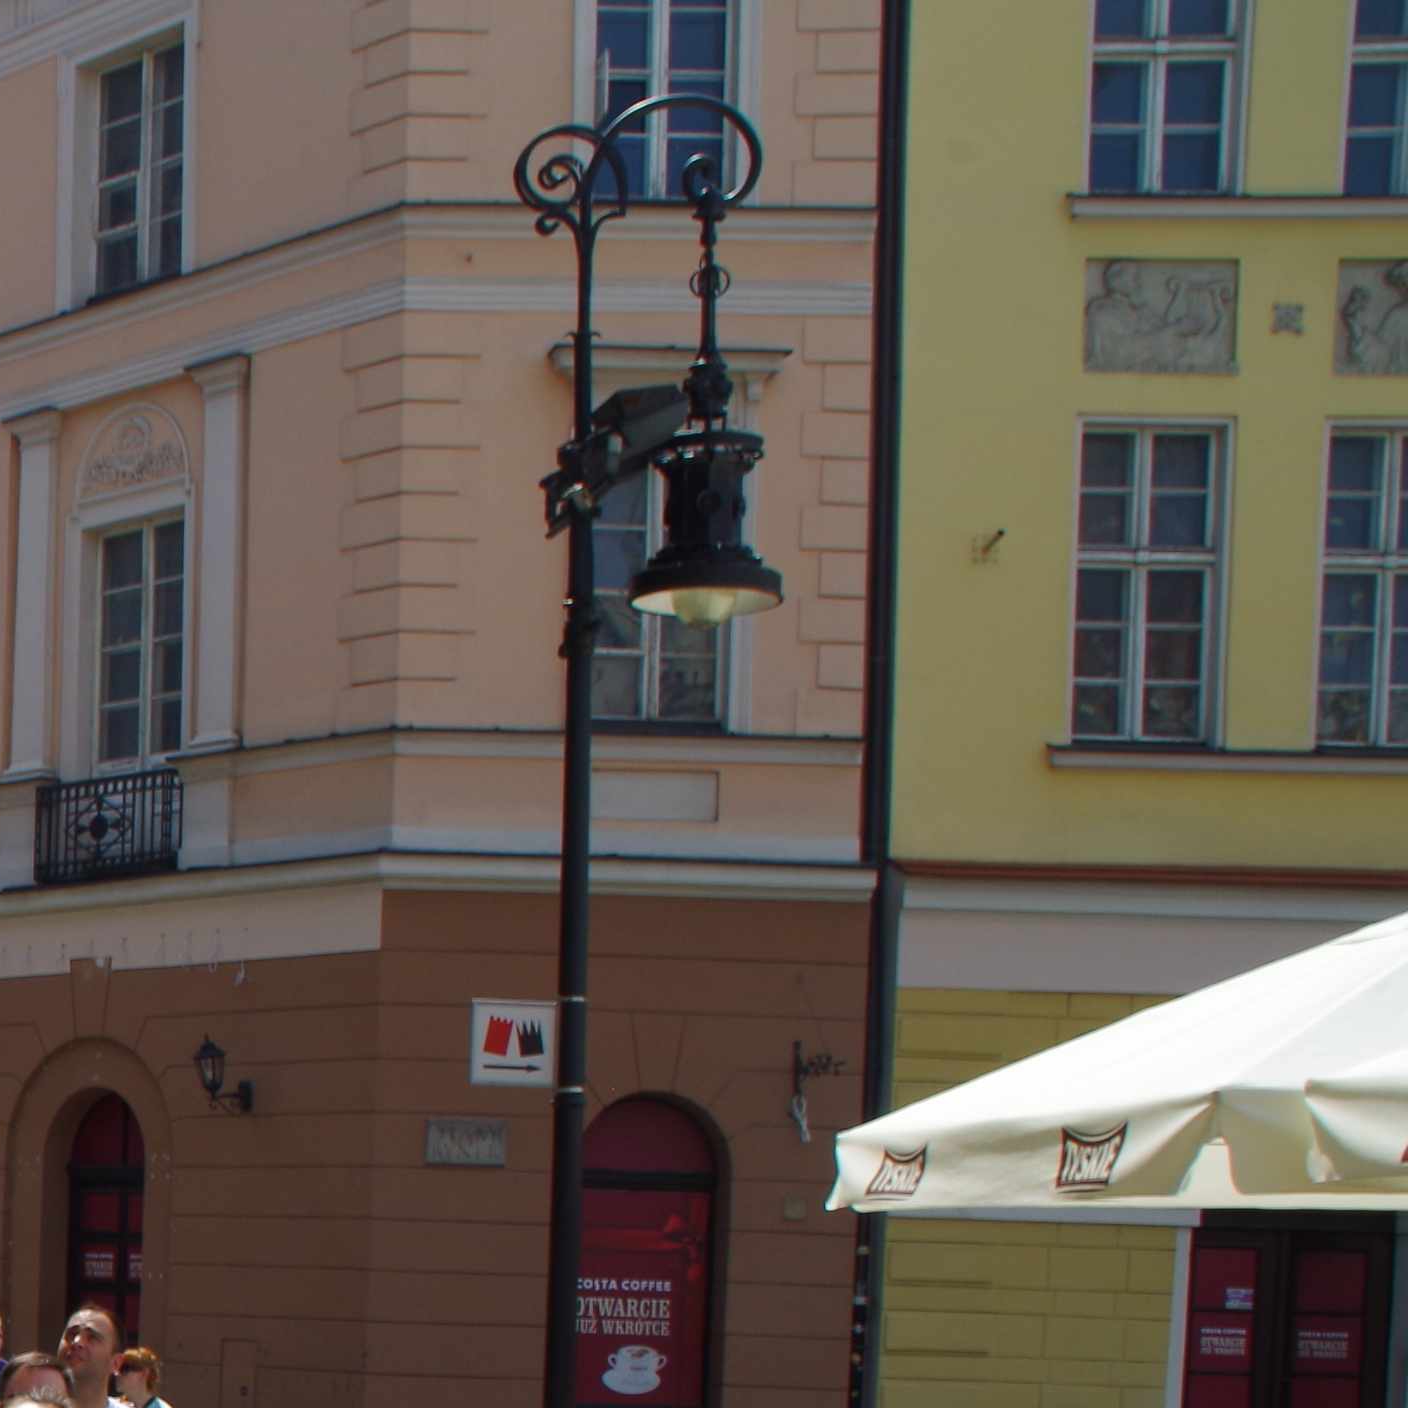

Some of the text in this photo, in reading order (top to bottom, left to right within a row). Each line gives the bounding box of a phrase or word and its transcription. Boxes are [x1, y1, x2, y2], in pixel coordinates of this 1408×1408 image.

[1057, 1136, 1122, 1182] TYSKIE
[621, 1279, 672, 1292] COFFEE
[602, 1319, 671, 1337] WKRÓTCE
